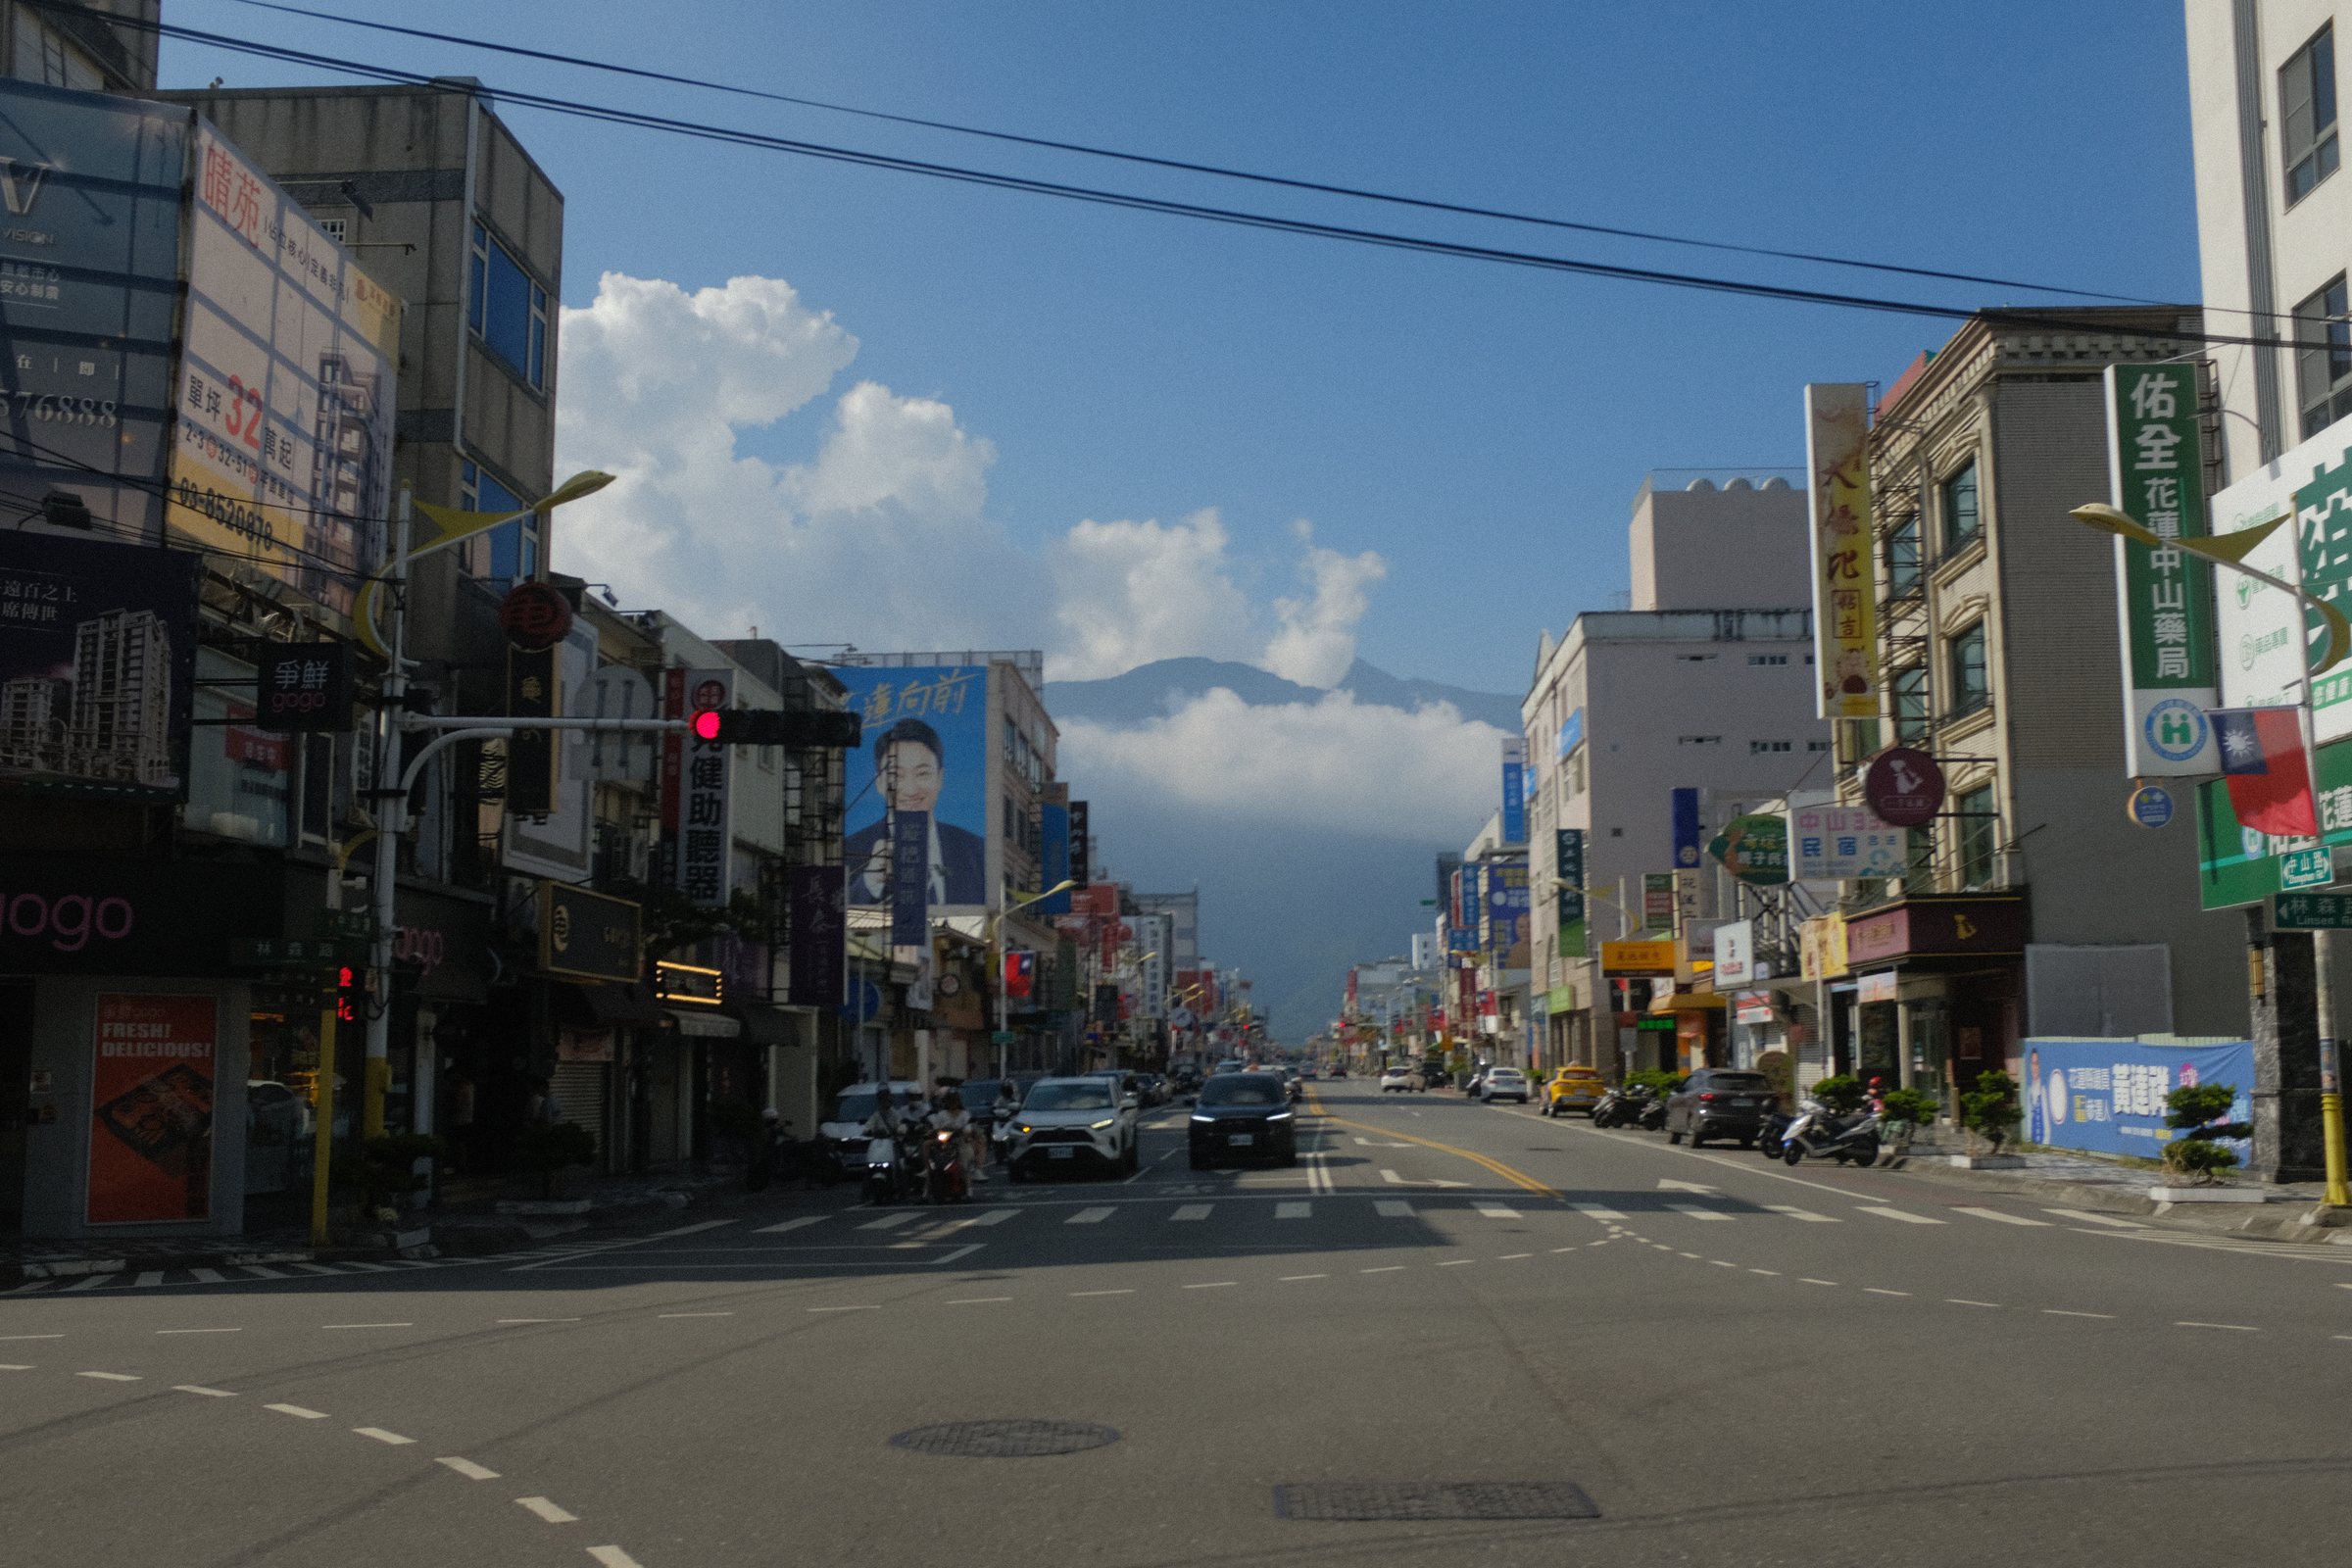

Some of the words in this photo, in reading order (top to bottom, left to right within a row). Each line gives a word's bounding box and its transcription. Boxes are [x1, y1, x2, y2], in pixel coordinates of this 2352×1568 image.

[205, 144, 261, 249] 晴苑
[273, 659, 329, 690] 爭鮮
[271, 691, 326, 714] gogo
[1801, 836, 1857, 858] 民宿
[0, 892, 134, 953] ogo
[102, 1022, 172, 1039] FRESH!
[101, 1041, 212, 1058] DELICIOUS!
